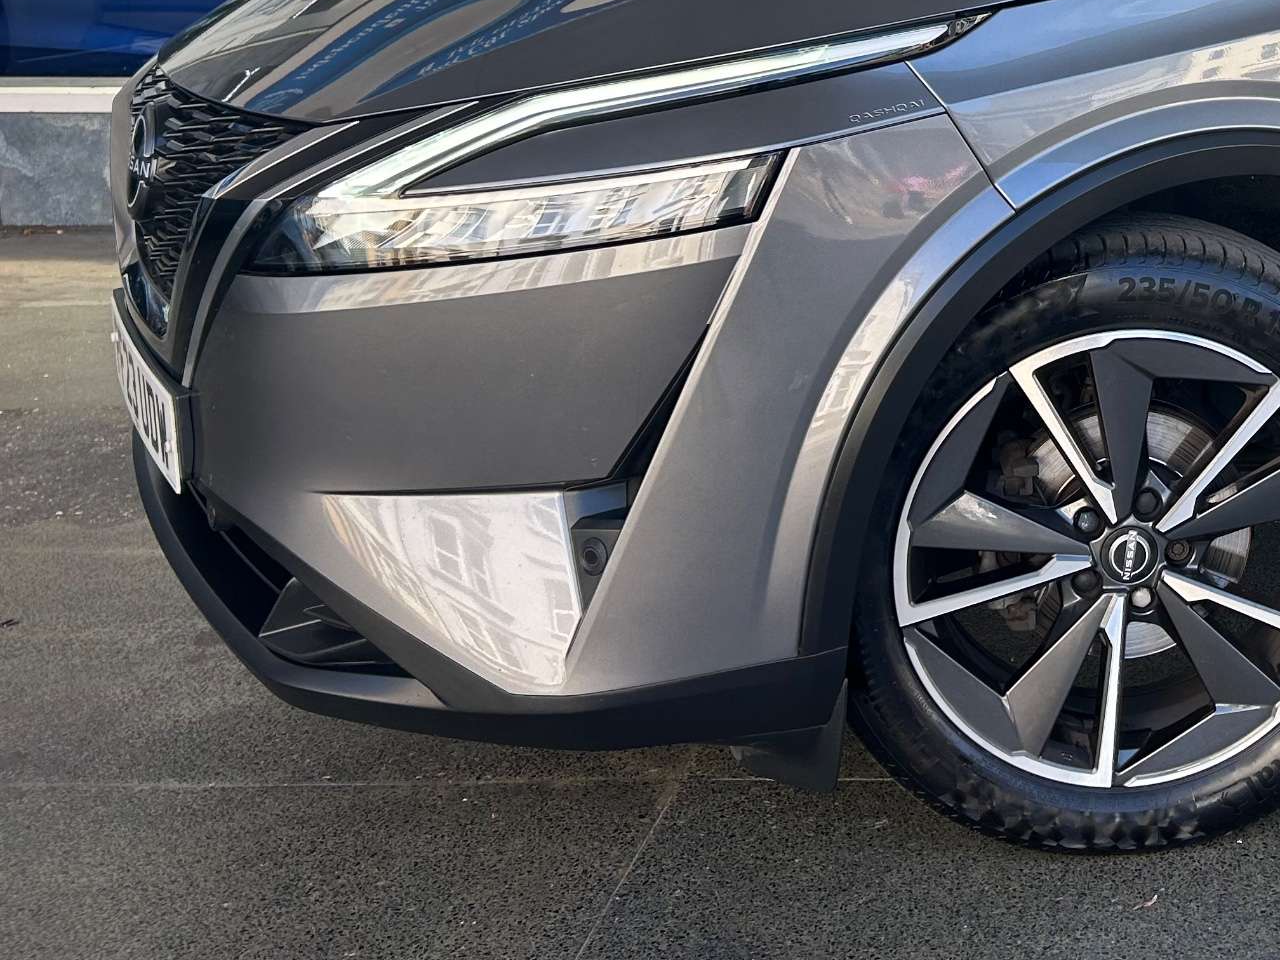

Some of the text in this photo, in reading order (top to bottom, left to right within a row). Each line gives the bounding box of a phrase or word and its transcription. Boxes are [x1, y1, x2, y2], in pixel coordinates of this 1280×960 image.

[849, 99, 926, 123] QASHQAI
[1117, 277, 1233, 314] 235/50
[1122, 529, 1138, 580] NISSAN
